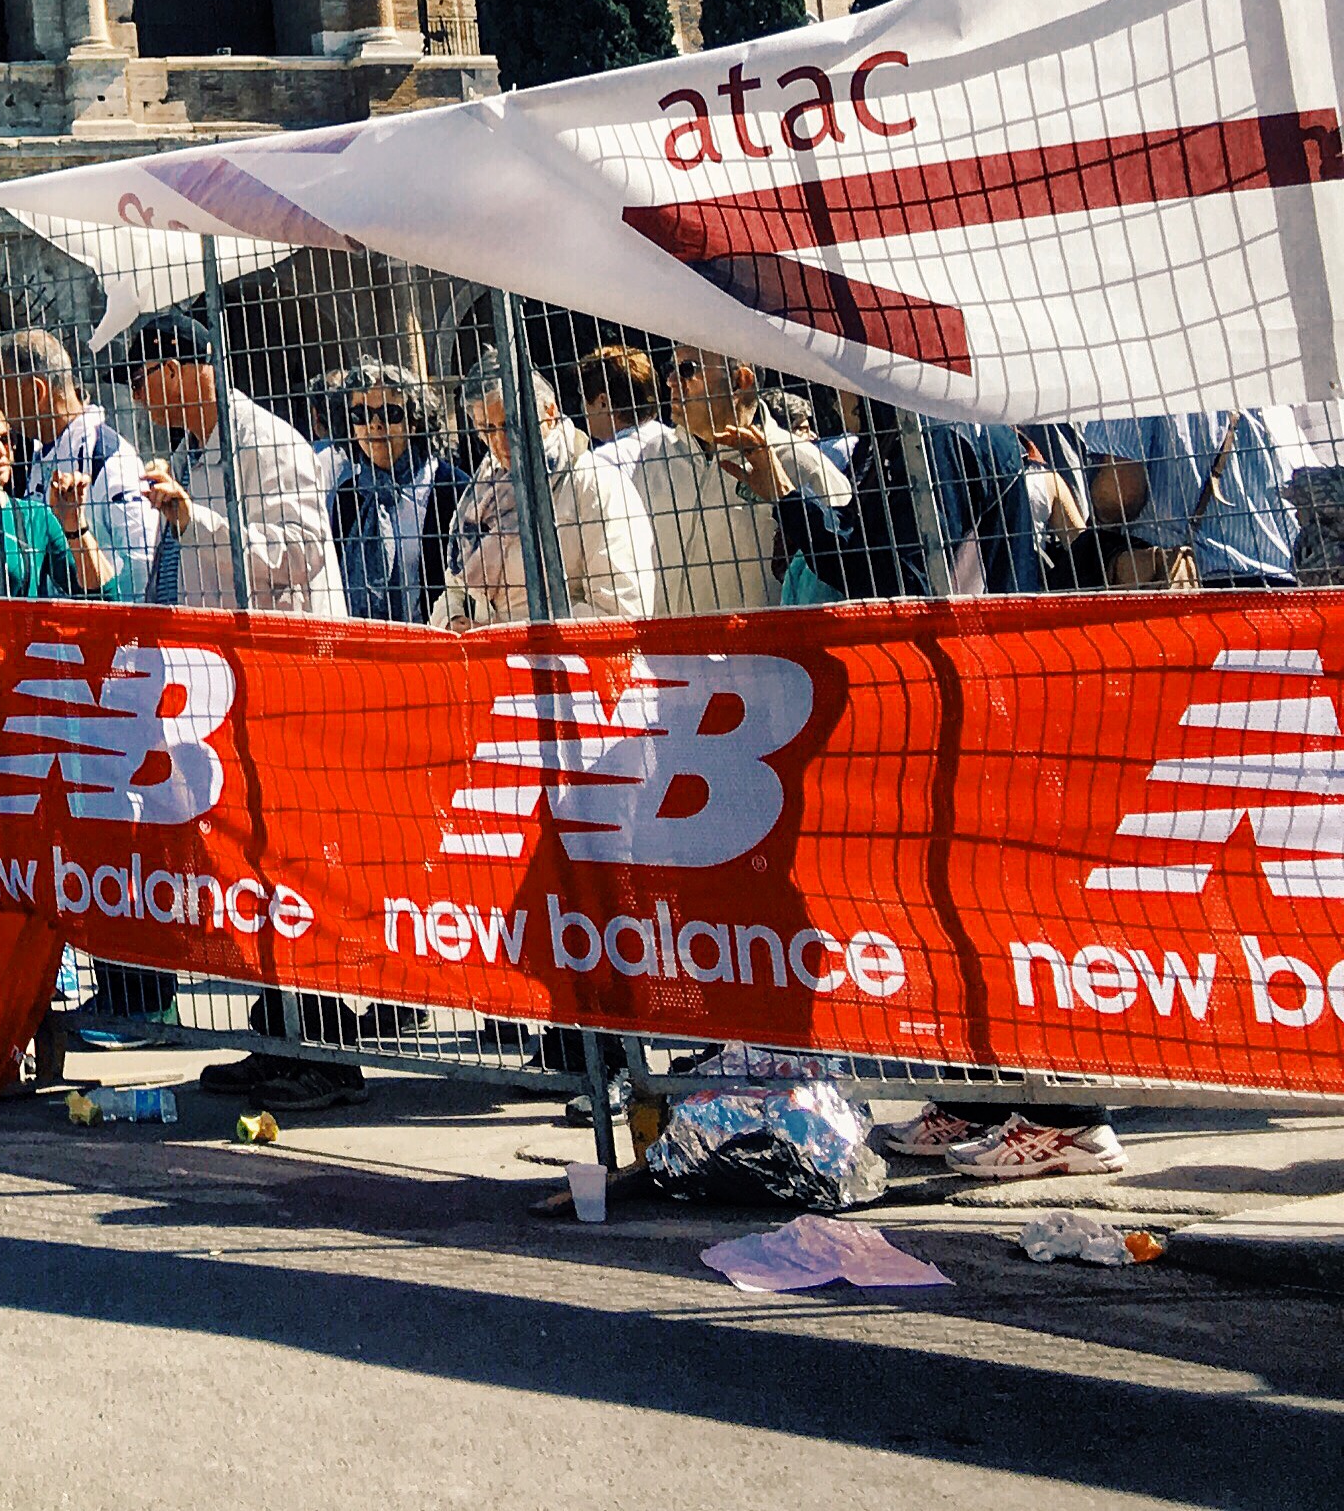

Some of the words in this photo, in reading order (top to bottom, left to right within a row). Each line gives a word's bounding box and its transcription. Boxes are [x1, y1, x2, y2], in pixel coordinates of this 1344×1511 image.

[658, 50, 917, 172] atac
[439, 653, 813, 866] NB
[52, 845, 315, 939] balance
[384, 896, 528, 965] new
[548, 894, 907, 997] balance
[1010, 941, 1216, 1021] new
